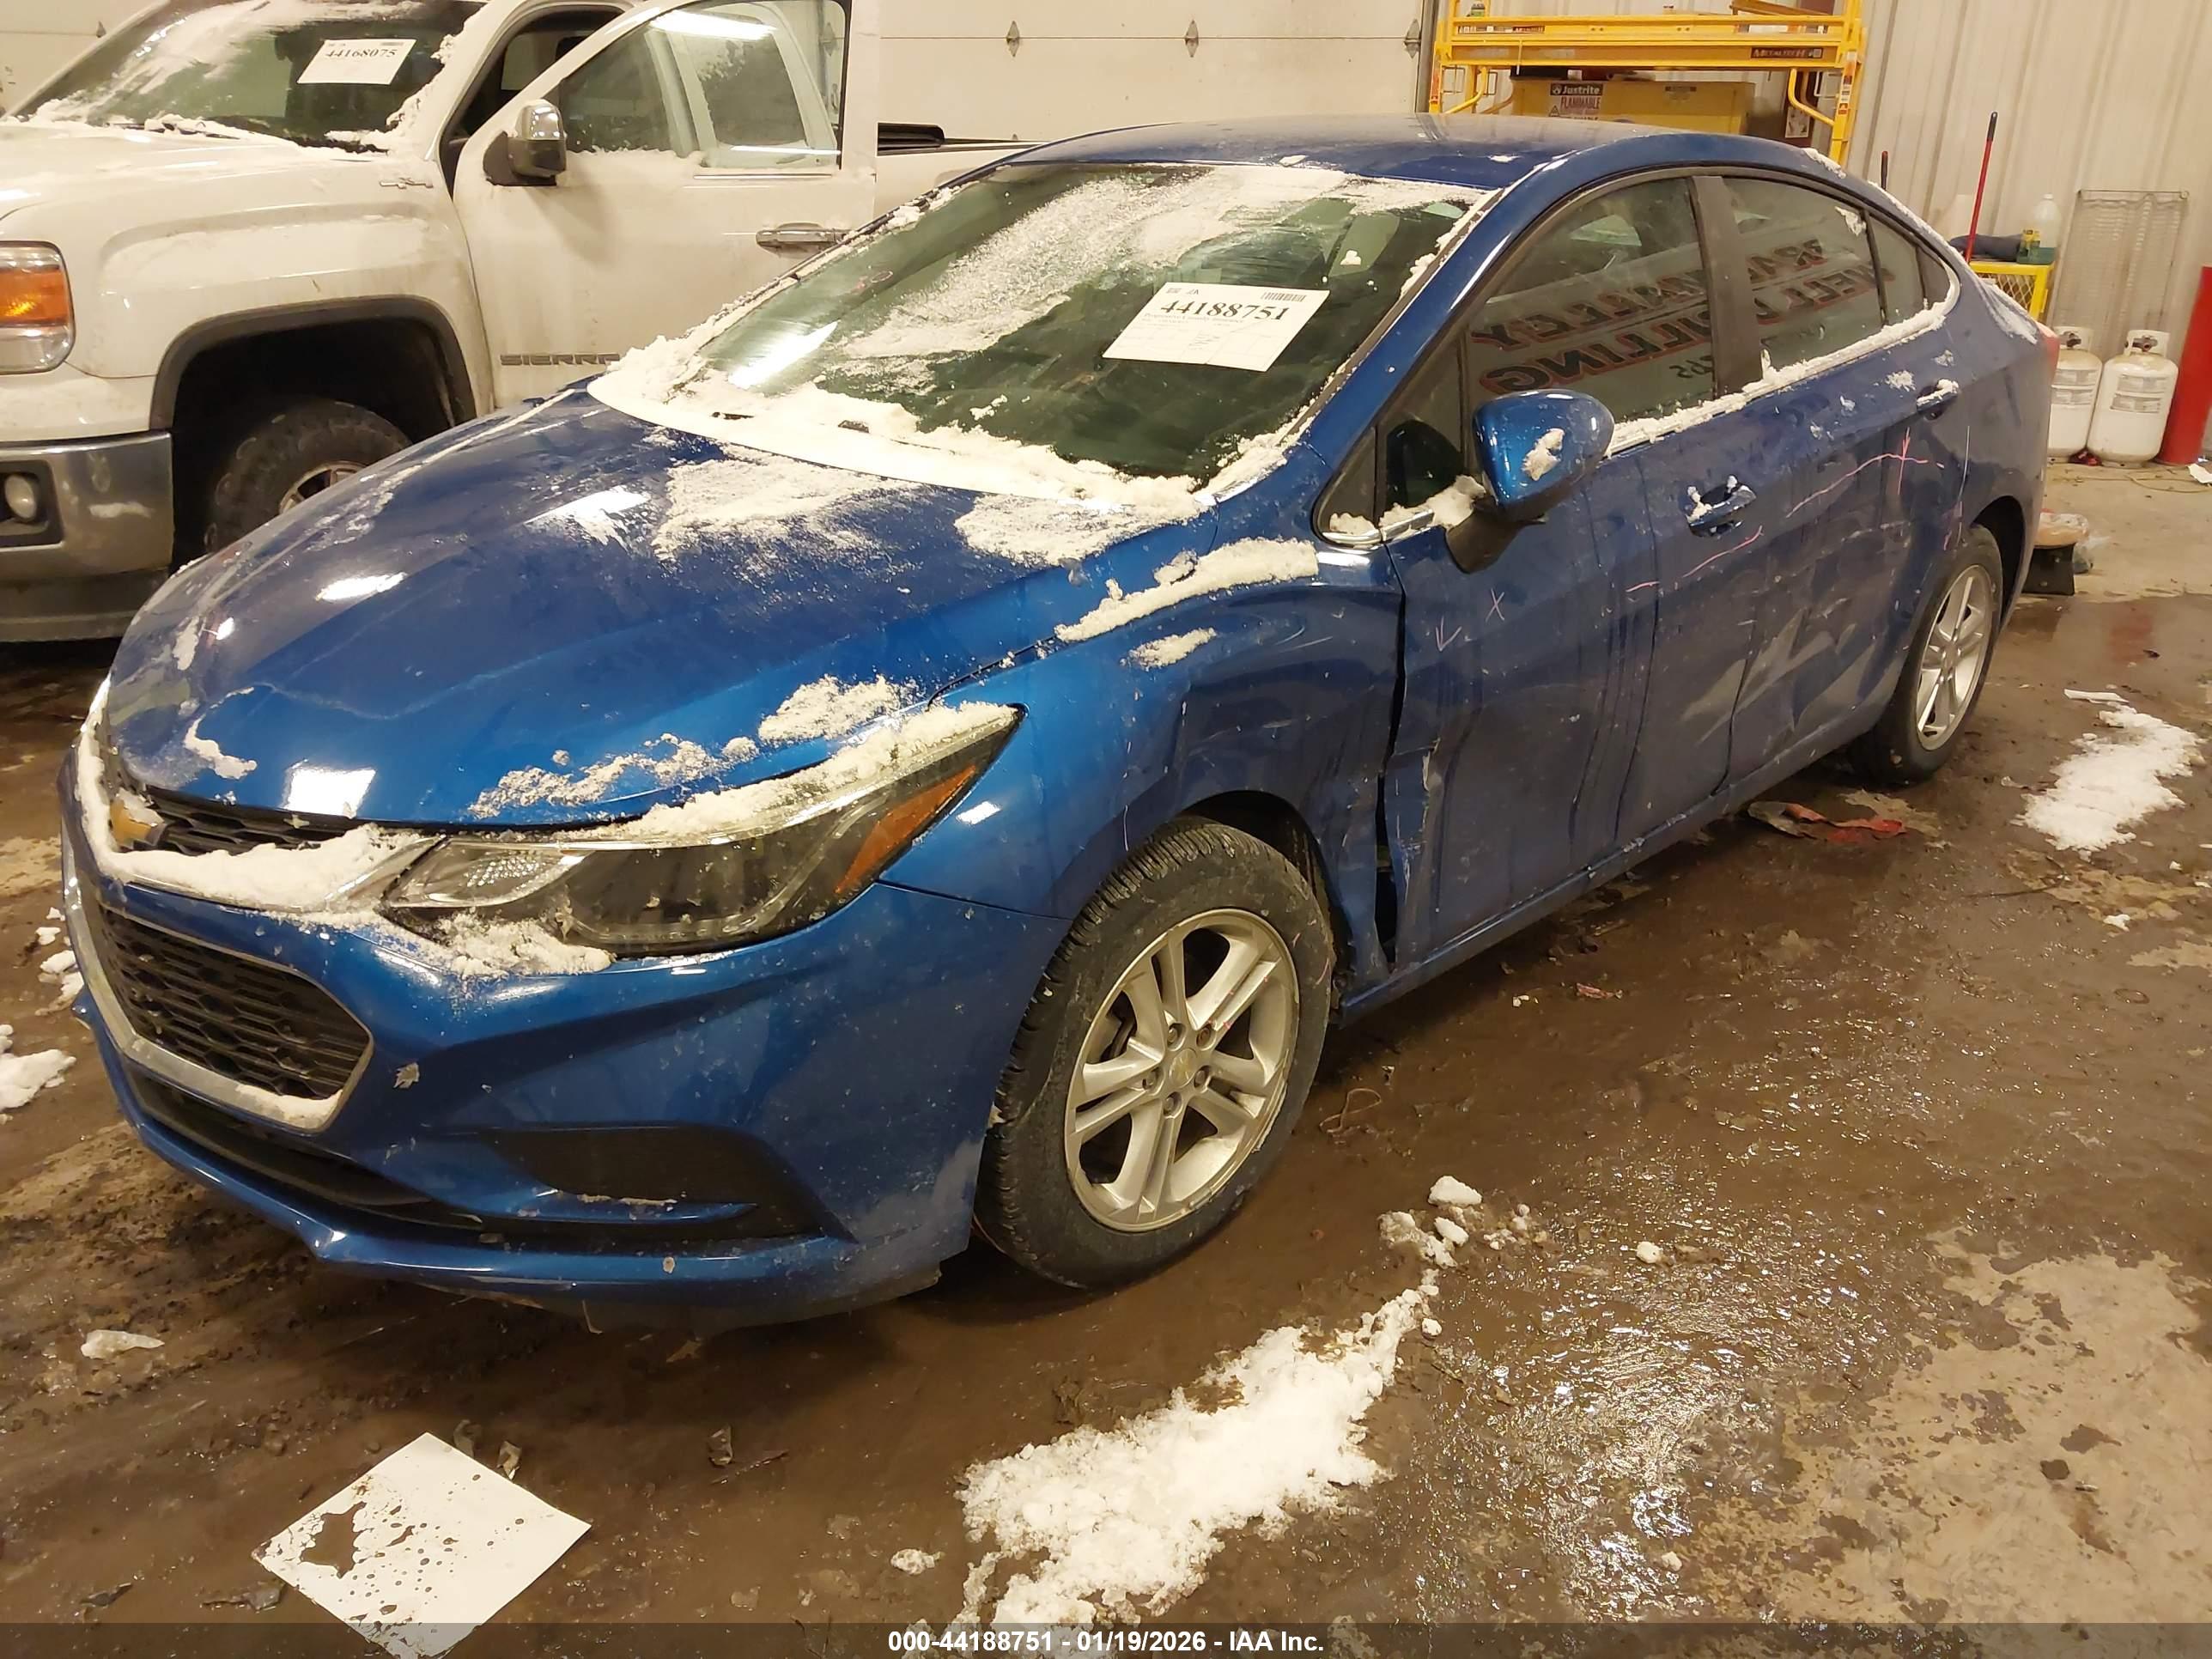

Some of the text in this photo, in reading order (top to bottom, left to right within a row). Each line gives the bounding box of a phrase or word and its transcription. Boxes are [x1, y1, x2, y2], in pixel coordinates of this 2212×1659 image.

[326, 49, 397, 58] 44168075
[1563, 85, 1601, 94] Justrite
[1160, 300, 1291, 320] 44188751
